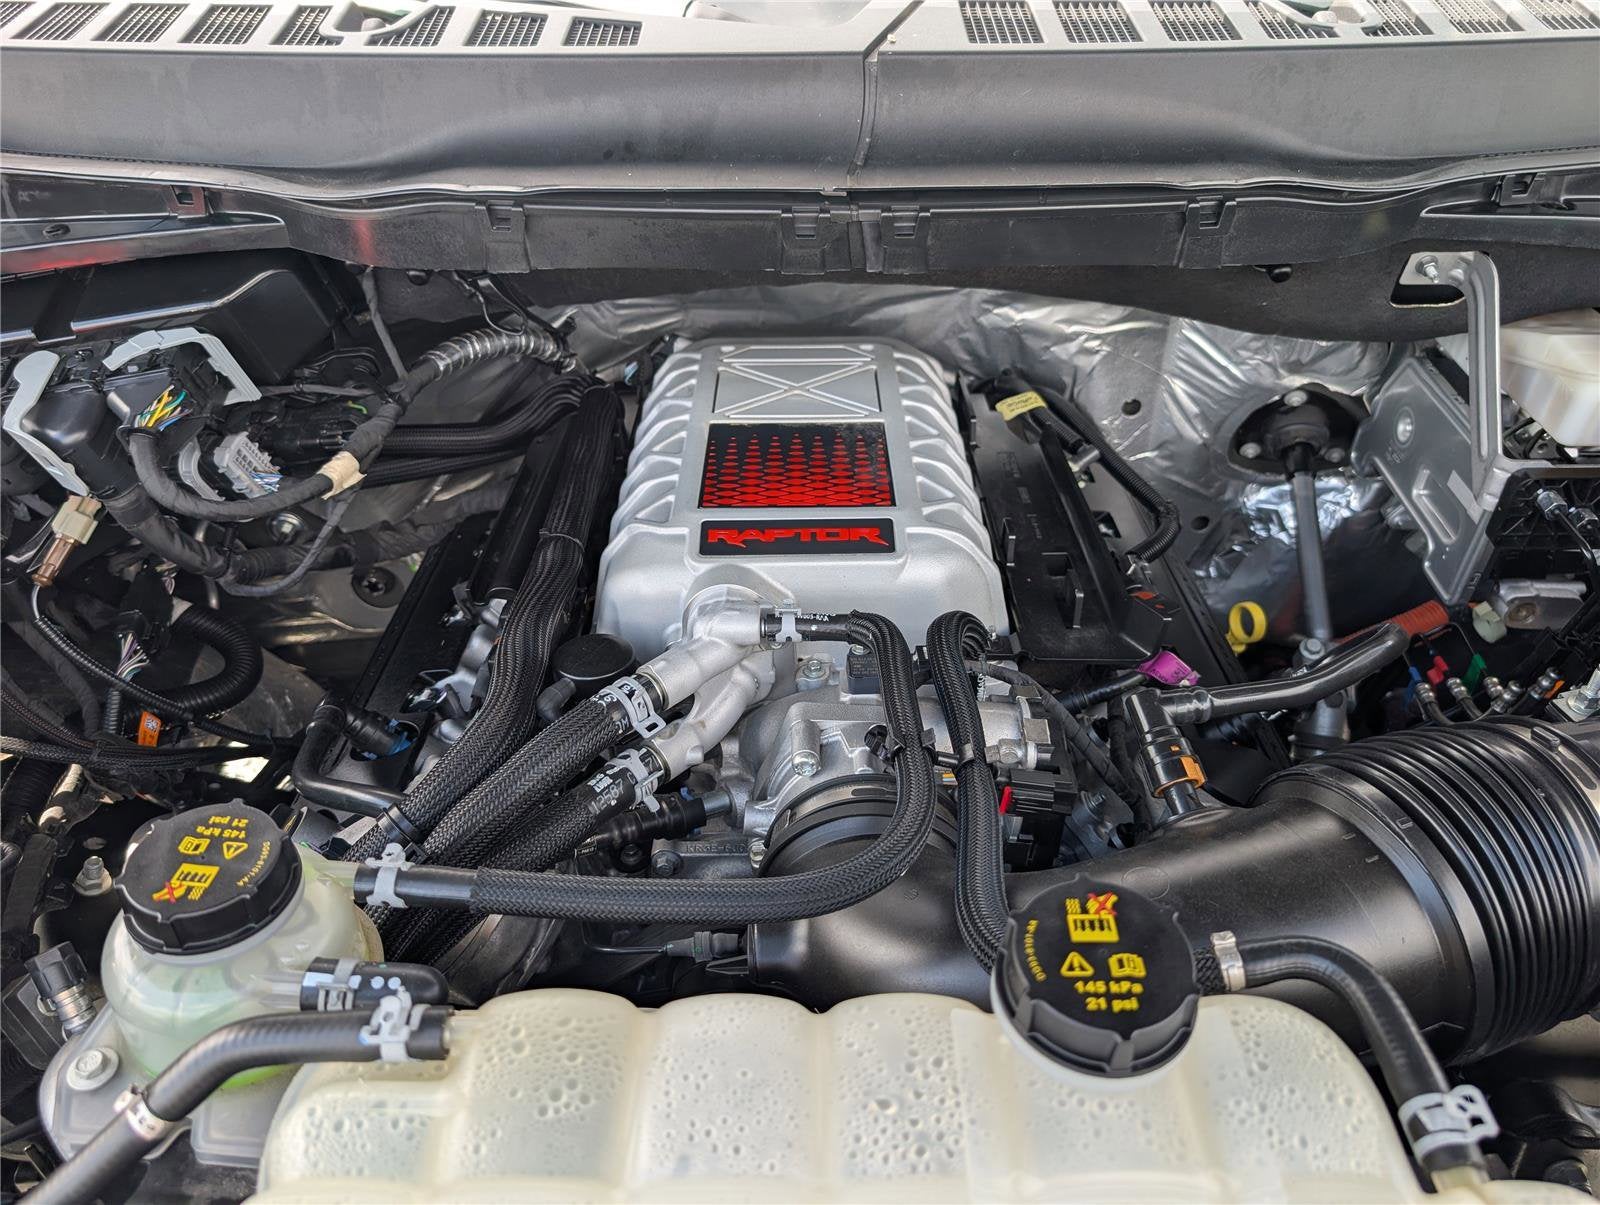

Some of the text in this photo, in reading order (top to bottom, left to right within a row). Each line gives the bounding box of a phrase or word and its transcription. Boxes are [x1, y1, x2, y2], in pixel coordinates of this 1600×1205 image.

[707, 527, 889, 547] RAPTOR
[209, 816, 248, 827] 21 psi
[196, 826, 246, 838] 145 kPa
[1074, 981, 1143, 994] 145 kPa
[1085, 997, 1139, 1013] 21 psi
